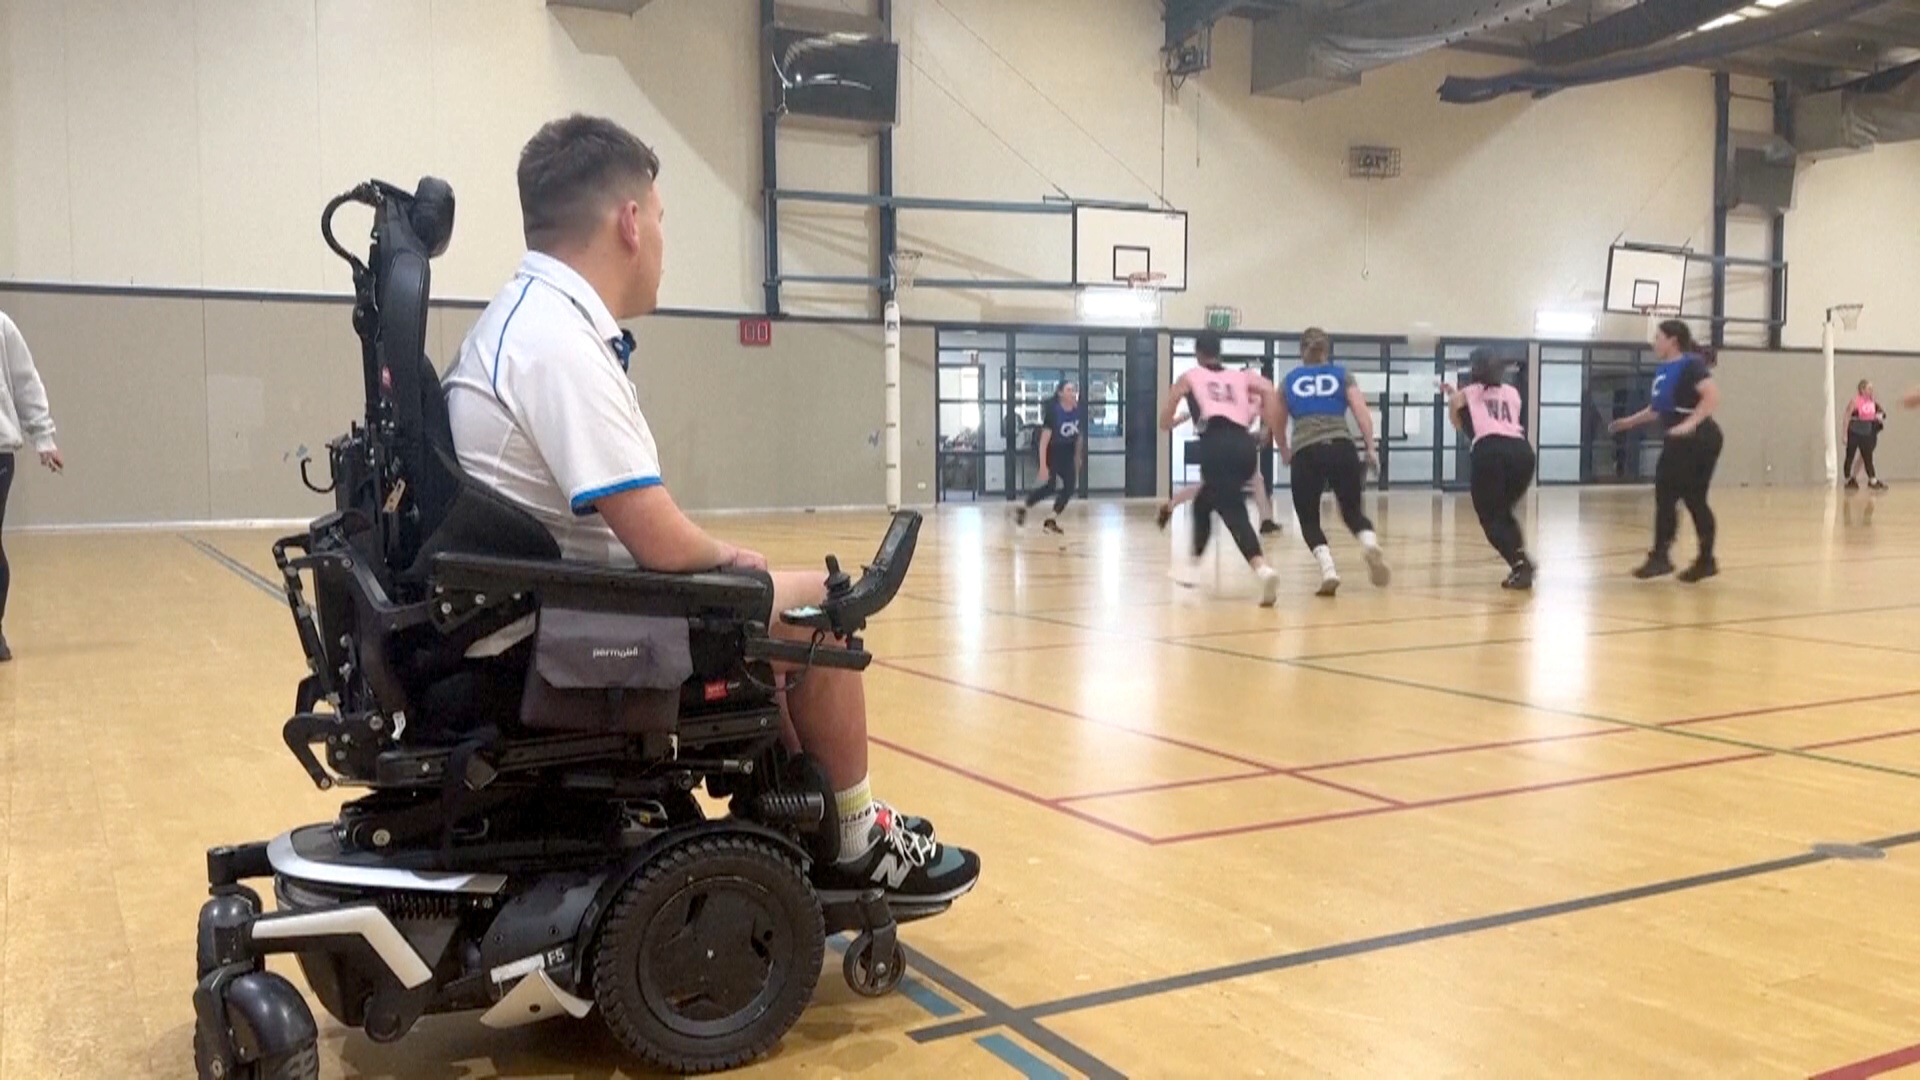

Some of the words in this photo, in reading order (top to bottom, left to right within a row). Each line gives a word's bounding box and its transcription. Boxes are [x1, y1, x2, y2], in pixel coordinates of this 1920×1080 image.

[1291, 373, 1339, 396] GD
[1484, 398, 1512, 424] WA
[1060, 419, 1079, 436] GK
[547, 947, 565, 965] F5
